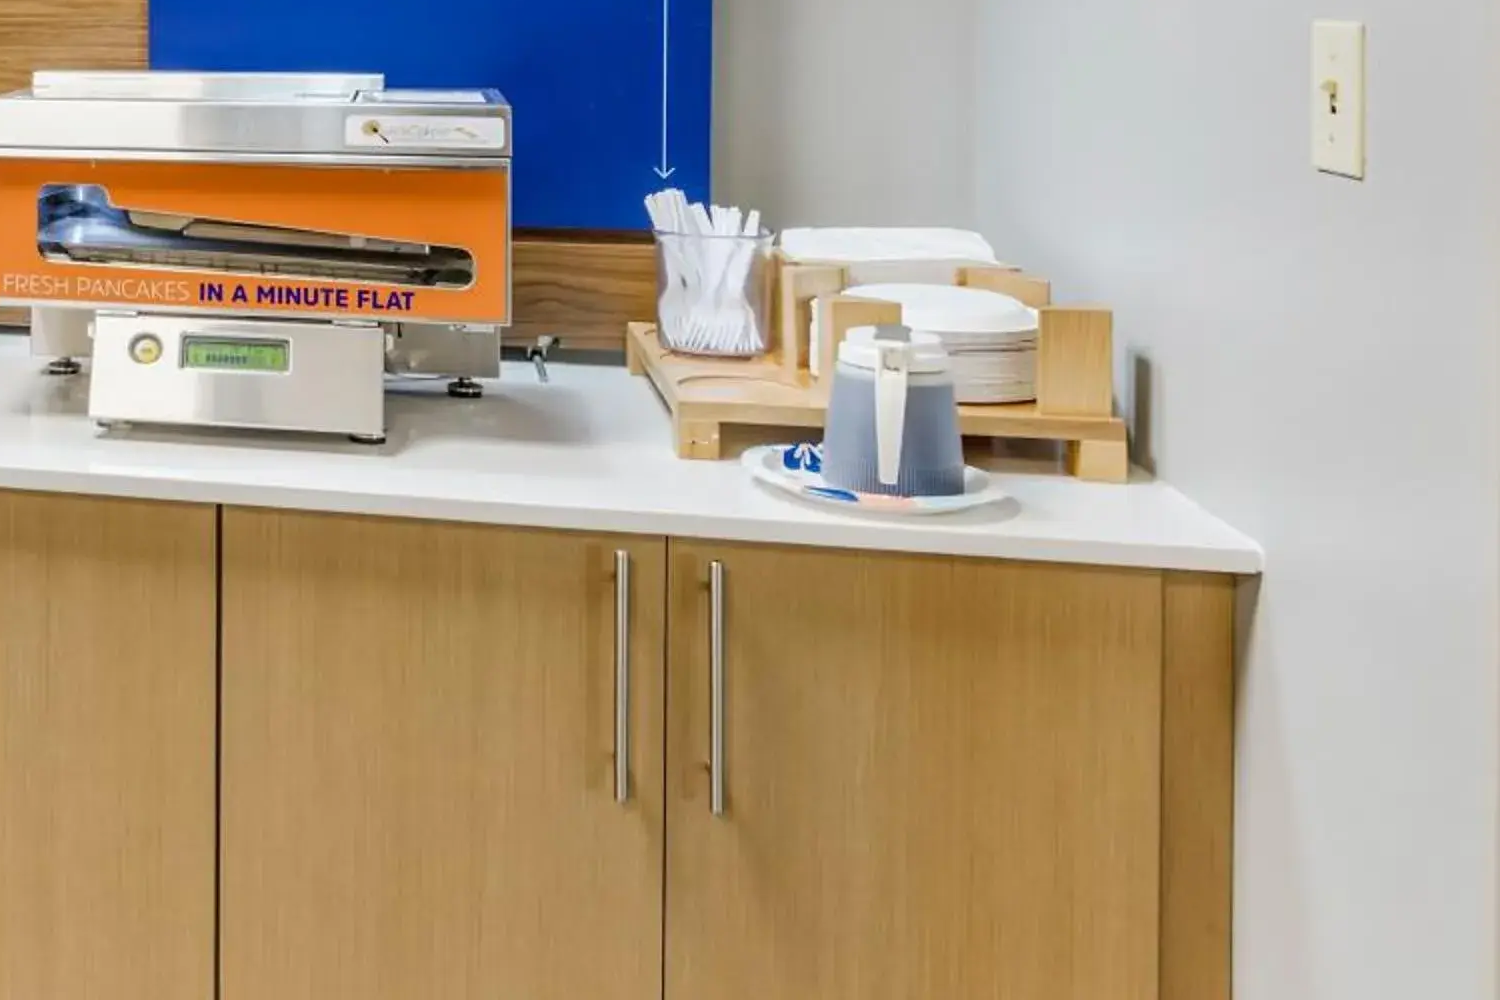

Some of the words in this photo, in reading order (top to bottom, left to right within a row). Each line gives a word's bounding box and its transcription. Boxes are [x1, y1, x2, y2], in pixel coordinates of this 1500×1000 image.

[3, 274, 69, 296] FRESH
[77, 276, 191, 301] PANCAKES
[199, 283, 223, 301] IN
[232, 284, 248, 302] A
[257, 285, 348, 308] MINUTE
[357, 289, 415, 311] FLAT
